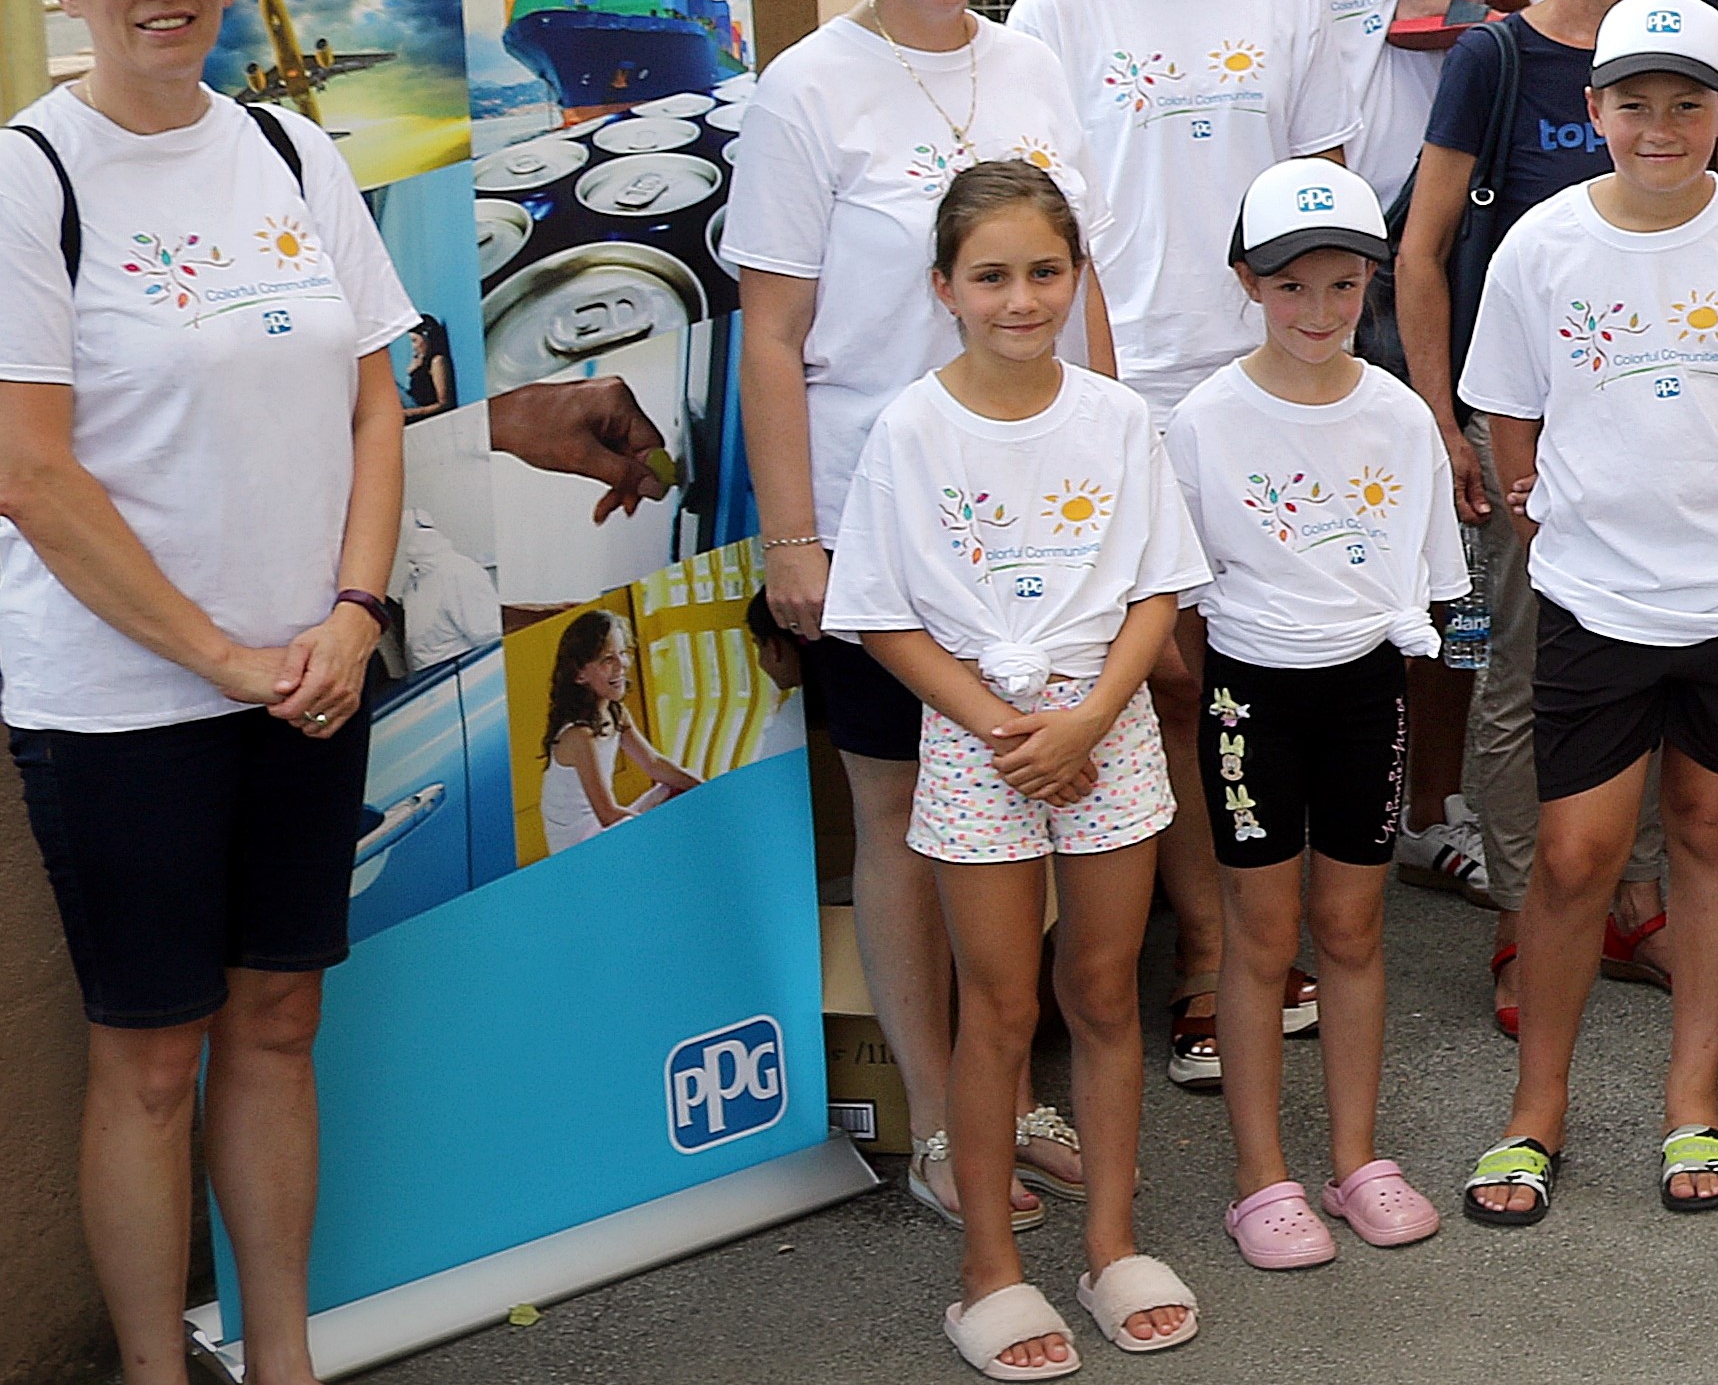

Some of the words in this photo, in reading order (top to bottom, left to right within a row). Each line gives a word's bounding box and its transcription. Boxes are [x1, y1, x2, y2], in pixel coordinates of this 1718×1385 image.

[1647, 10, 1682, 34] PPG
[1297, 186, 1335, 212] PPG
[206, 281, 257, 303] Colorful
[1614, 348, 1660, 367] Colorful
[1655, 378, 1681, 398] PPG
[986, 545, 1023, 562] olorful
[1017, 576, 1043, 598] PPG
[675, 1039, 778, 1133] PPG
